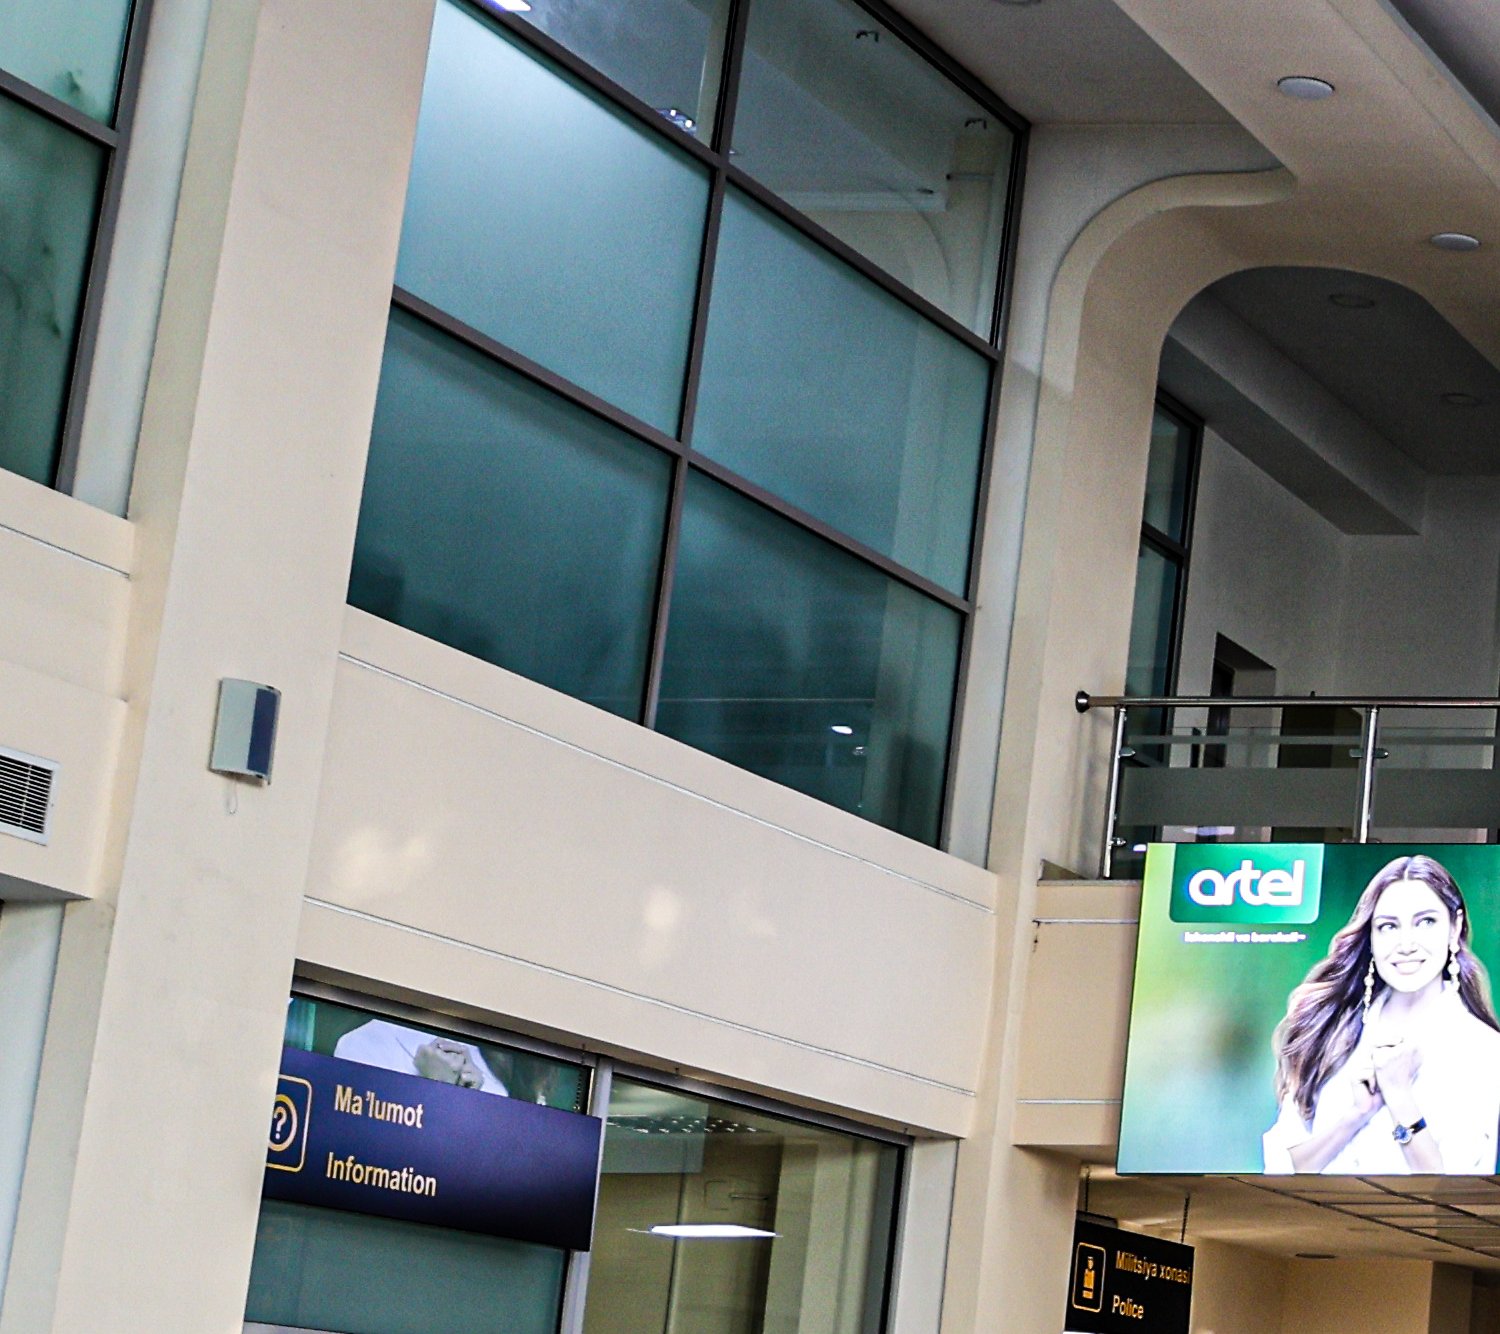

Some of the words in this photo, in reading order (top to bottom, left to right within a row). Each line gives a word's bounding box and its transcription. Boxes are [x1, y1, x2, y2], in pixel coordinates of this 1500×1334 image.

[1188, 859, 1306, 906] artel
[326, 1151, 437, 1197] Information
[1112, 1295, 1144, 1319] Police
